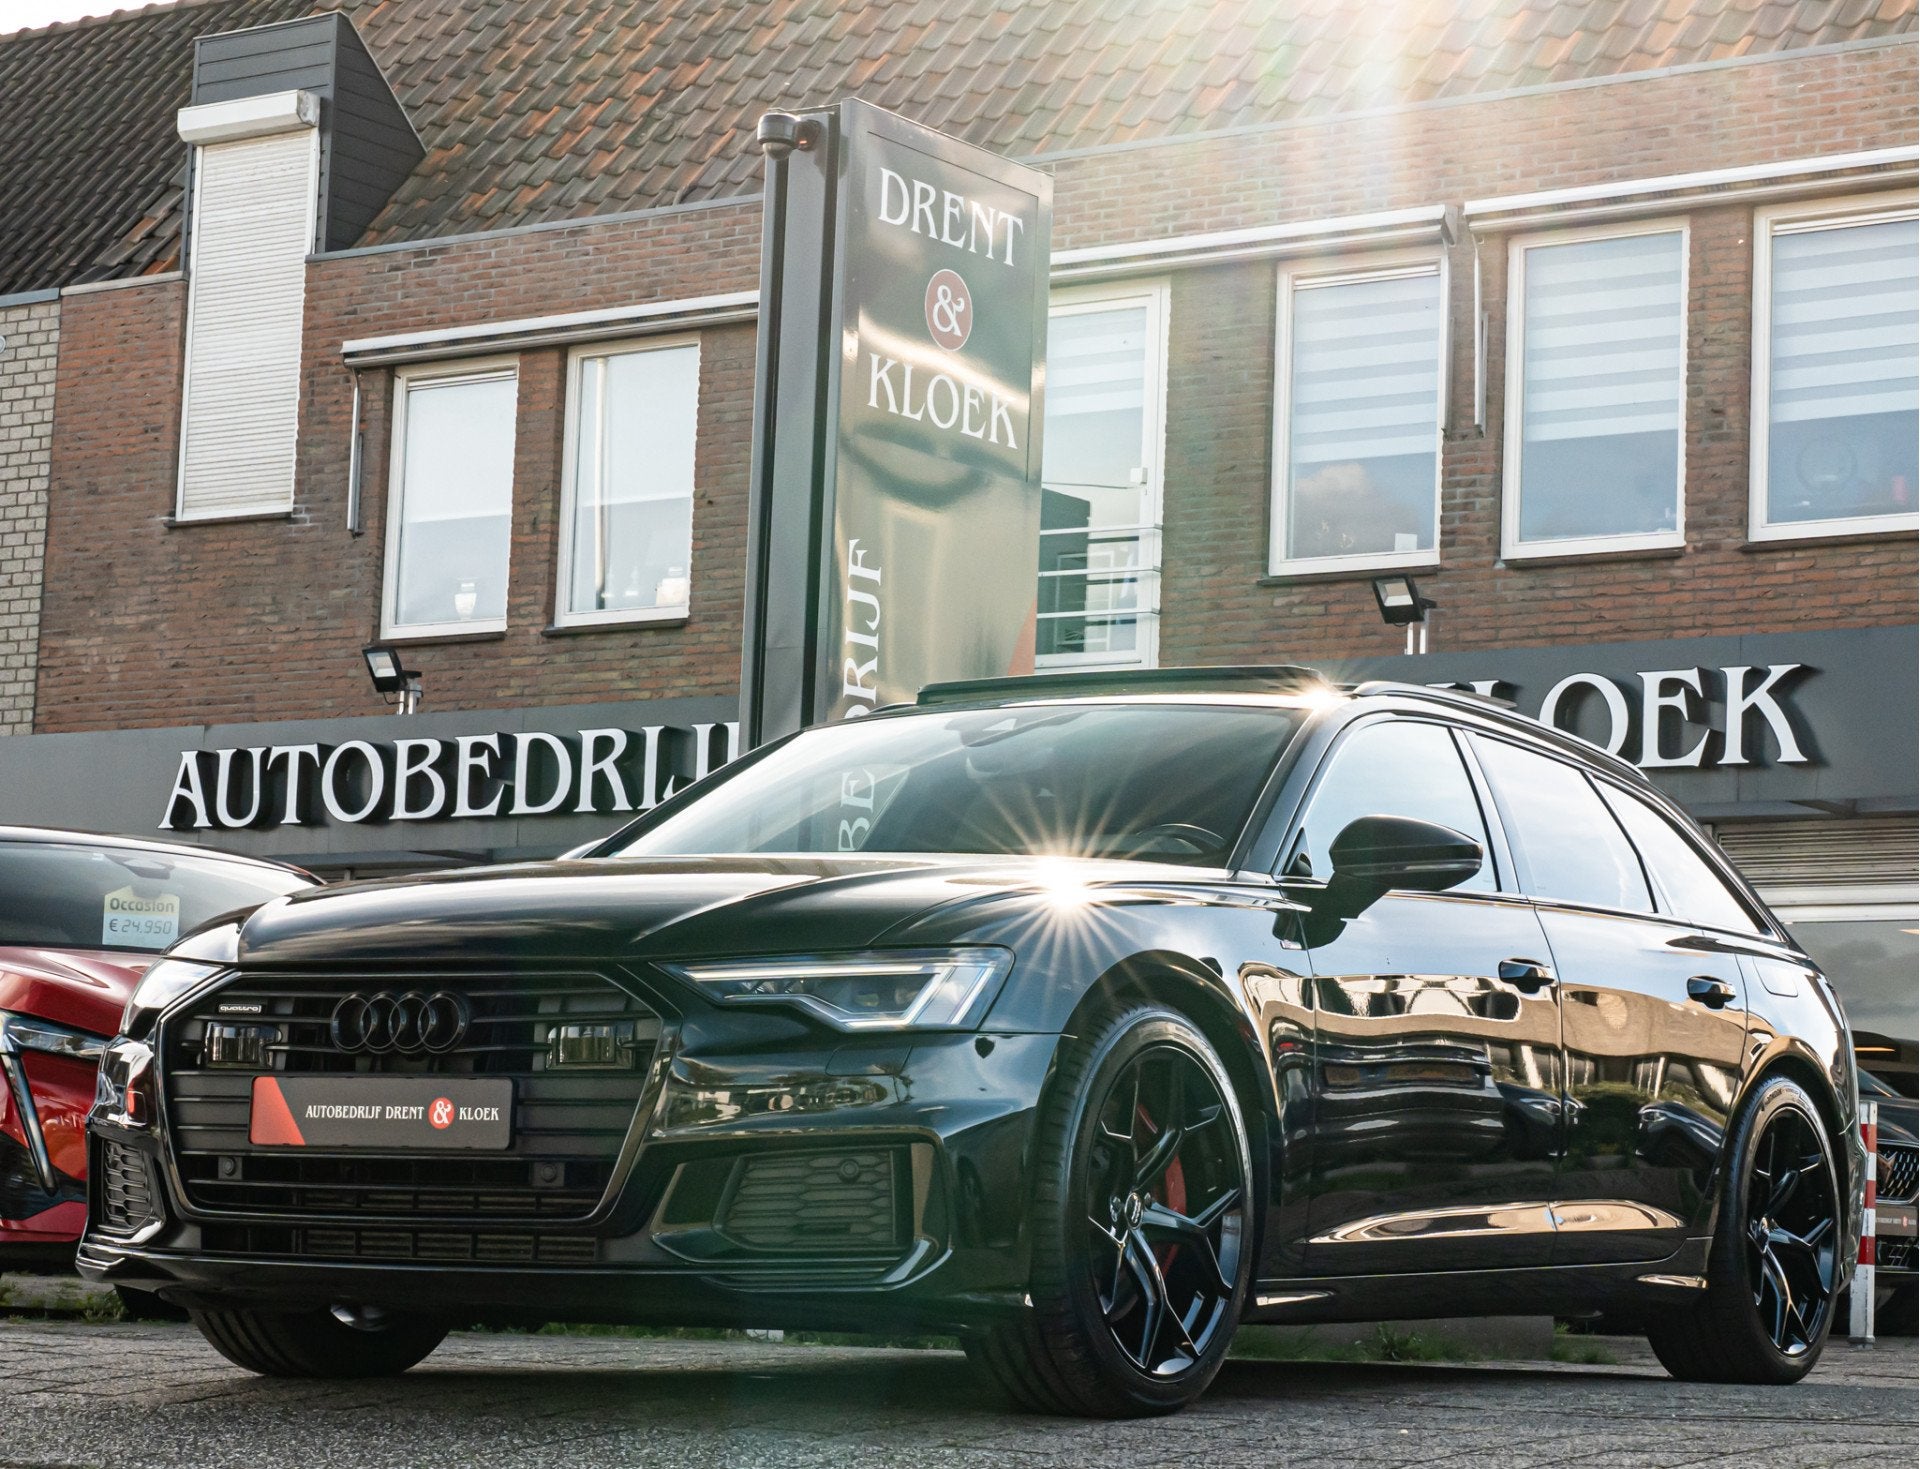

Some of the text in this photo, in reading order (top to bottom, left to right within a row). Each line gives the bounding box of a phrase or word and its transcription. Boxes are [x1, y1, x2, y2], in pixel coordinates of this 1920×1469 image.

[878, 167, 1024, 267] DRENT
[932, 285, 965, 338] &
[867, 352, 1018, 450] KLOEK
[1425, 663, 1808, 768] OEK
[109, 897, 174, 912] Occasion
[305, 1100, 499, 1124] AUTOBEDRIJF DRENT & KLOEK
